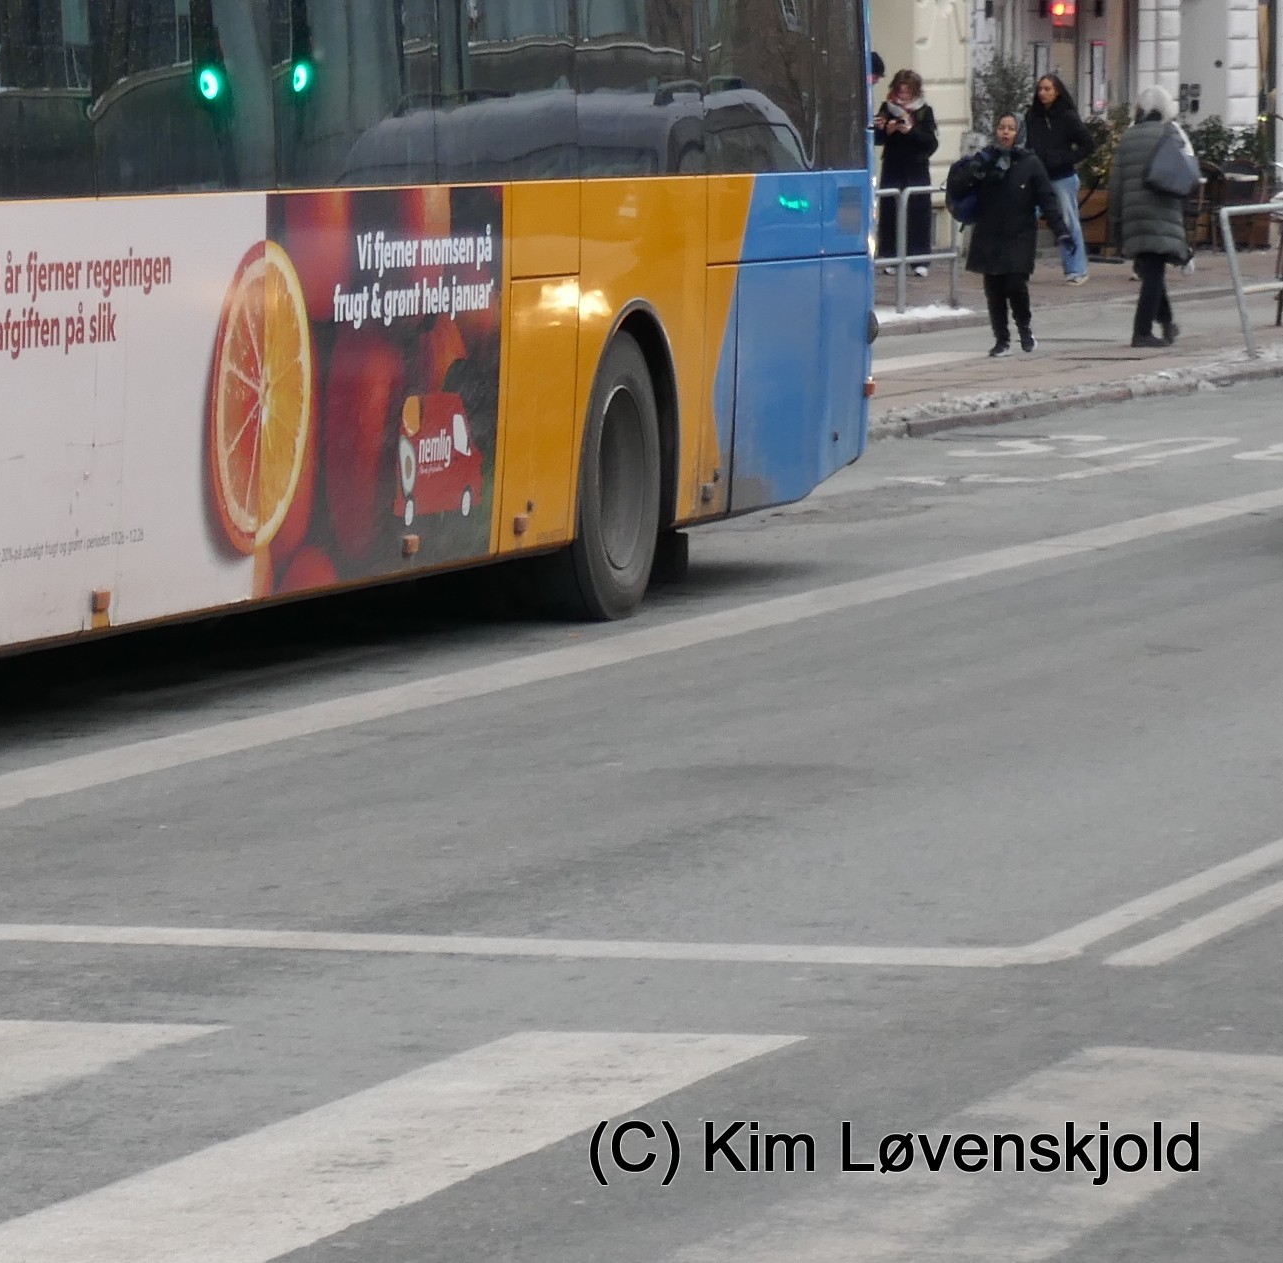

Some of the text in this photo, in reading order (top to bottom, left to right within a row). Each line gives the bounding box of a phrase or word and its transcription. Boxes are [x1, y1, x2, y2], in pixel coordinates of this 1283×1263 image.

[4, 250, 22, 295] år
[26, 251, 82, 303] fjerner
[86, 247, 172, 298] regeringen
[357, 224, 493, 278] Vi fjerner momsen på
[65, 301, 85, 355] på
[89, 301, 117, 344] slik
[334, 284, 370, 330] frugt
[370, 283, 382, 319] &
[384, 282, 421, 327] grønt
[422, 277, 450, 315] hele
[419, 428, 452, 468] nemlig
